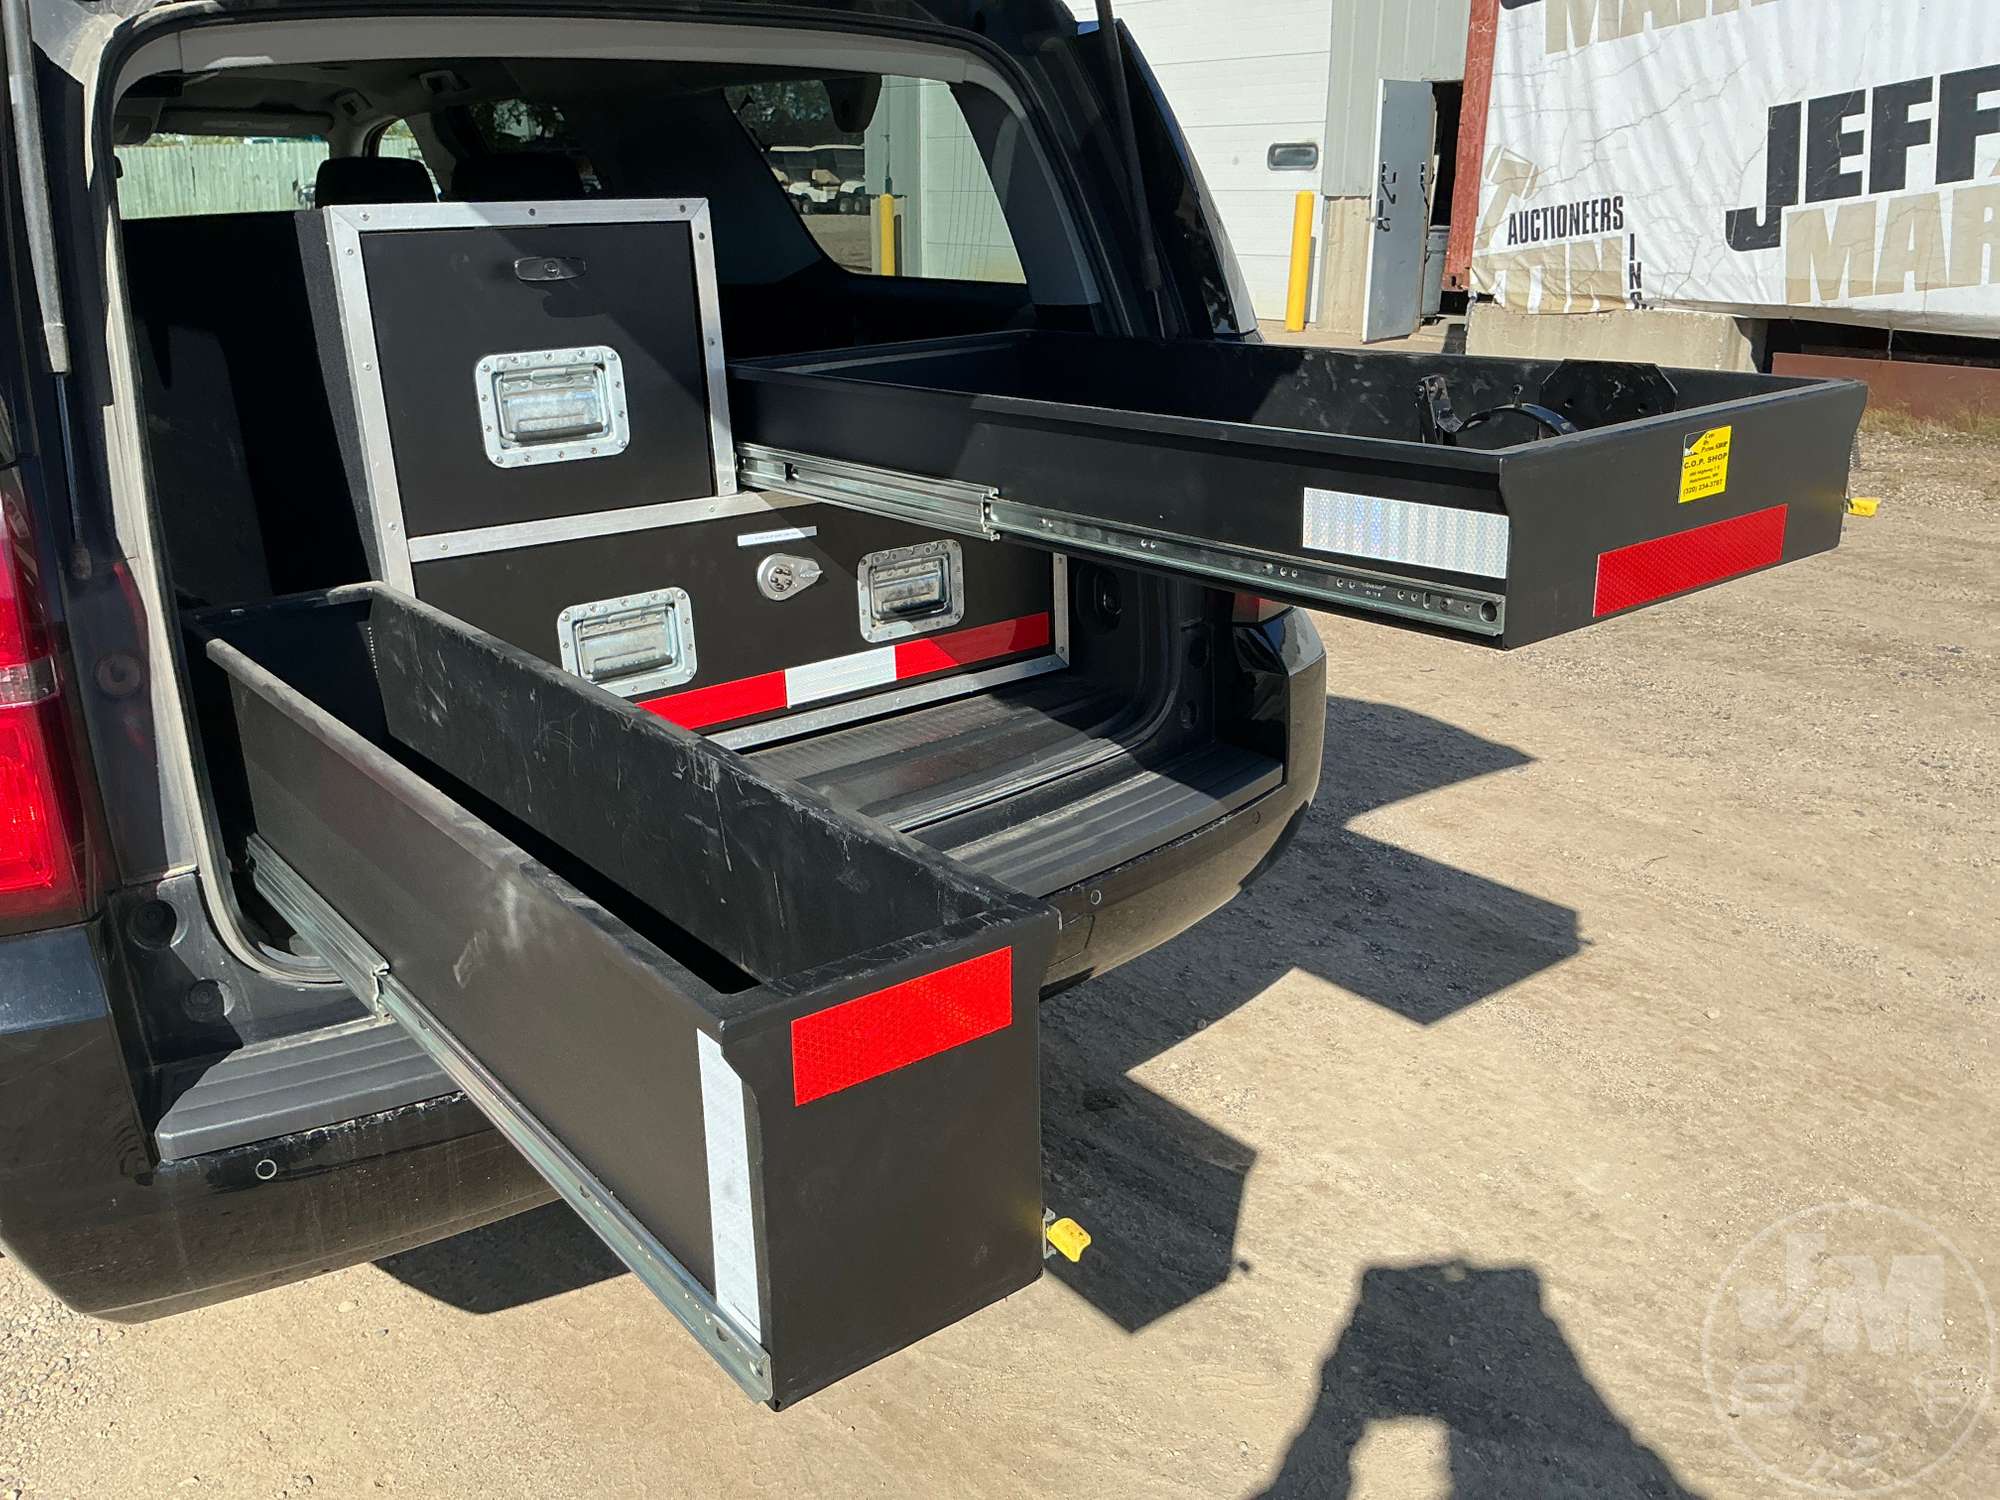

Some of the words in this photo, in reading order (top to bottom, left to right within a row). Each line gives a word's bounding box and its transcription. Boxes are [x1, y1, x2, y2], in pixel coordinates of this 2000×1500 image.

[1725, 64, 2000, 251] JEFF
[1507, 195, 1624, 246] AUCTIONEERS
[1707, 452, 1728, 463] SHOP
